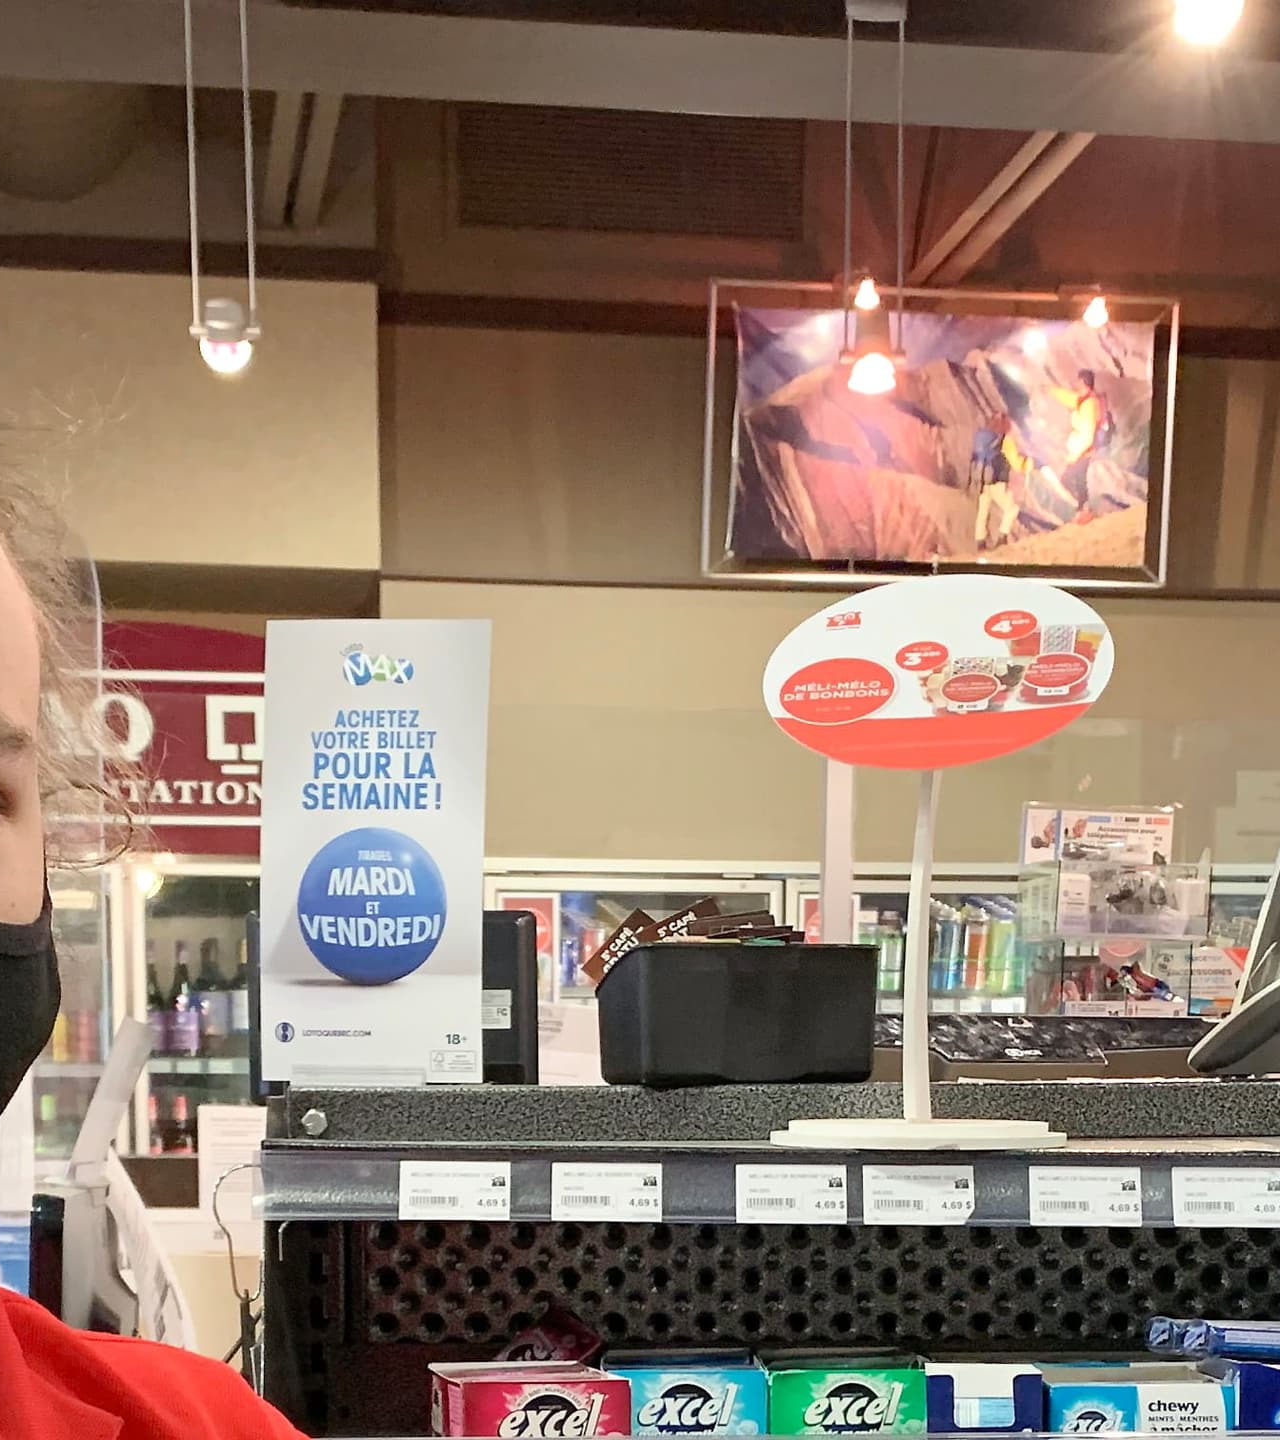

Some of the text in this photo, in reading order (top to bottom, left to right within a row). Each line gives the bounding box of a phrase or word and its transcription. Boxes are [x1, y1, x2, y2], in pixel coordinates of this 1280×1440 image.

[783, 687, 890, 702] DE BONBONS
[794, 678, 882, 694] MÉLI-MÉLO
[334, 709, 420, 729] ACHETEZ
[311, 731, 438, 749] VOTRE BILLET
[313, 753, 437, 779] POUR LA
[328, 866, 417, 897] MARDI
[365, 901, 381, 915] ET
[300, 914, 442, 949] VENDREDI
[670, 911, 698, 931] CAFÉ
[609, 926, 634, 953] CAFÉ
[497, 1392, 605, 1438] excel
[635, 1382, 735, 1428] excel
[803, 1382, 902, 1428] excel
[1148, 1399, 1199, 1418] chewy
